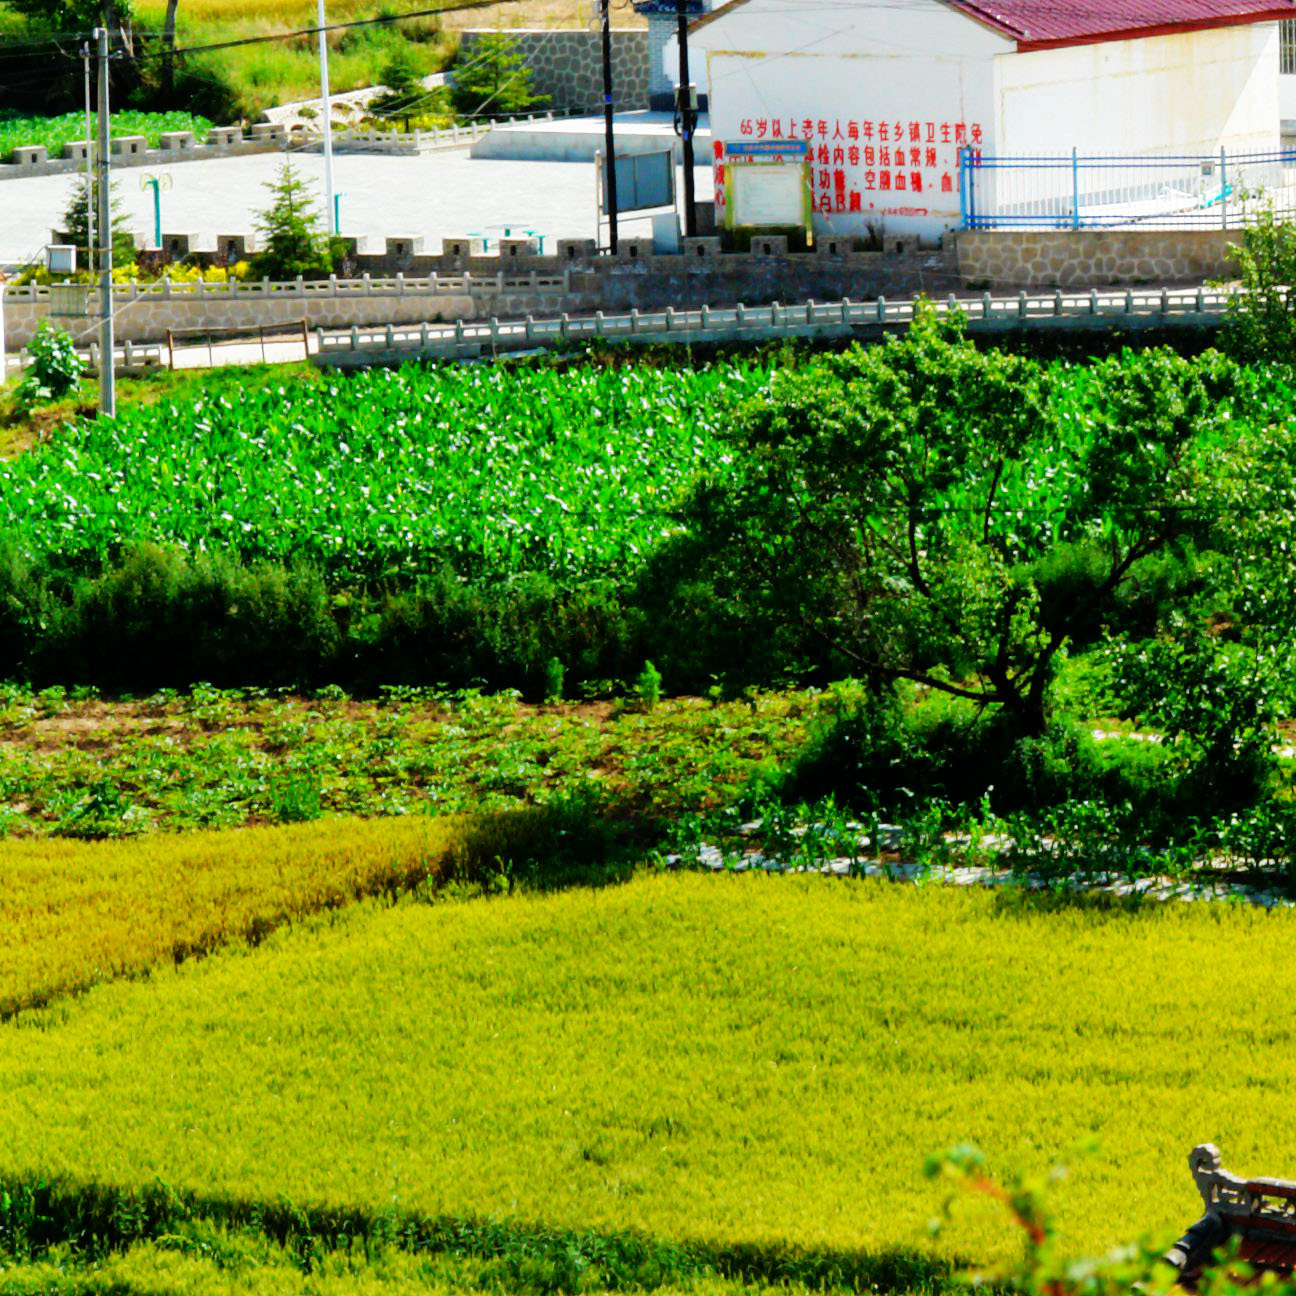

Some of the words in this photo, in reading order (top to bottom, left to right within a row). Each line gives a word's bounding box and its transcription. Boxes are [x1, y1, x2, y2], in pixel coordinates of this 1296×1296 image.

[740, 118, 982, 144] 65岁以上老年人每年在乡镇卫生院免
